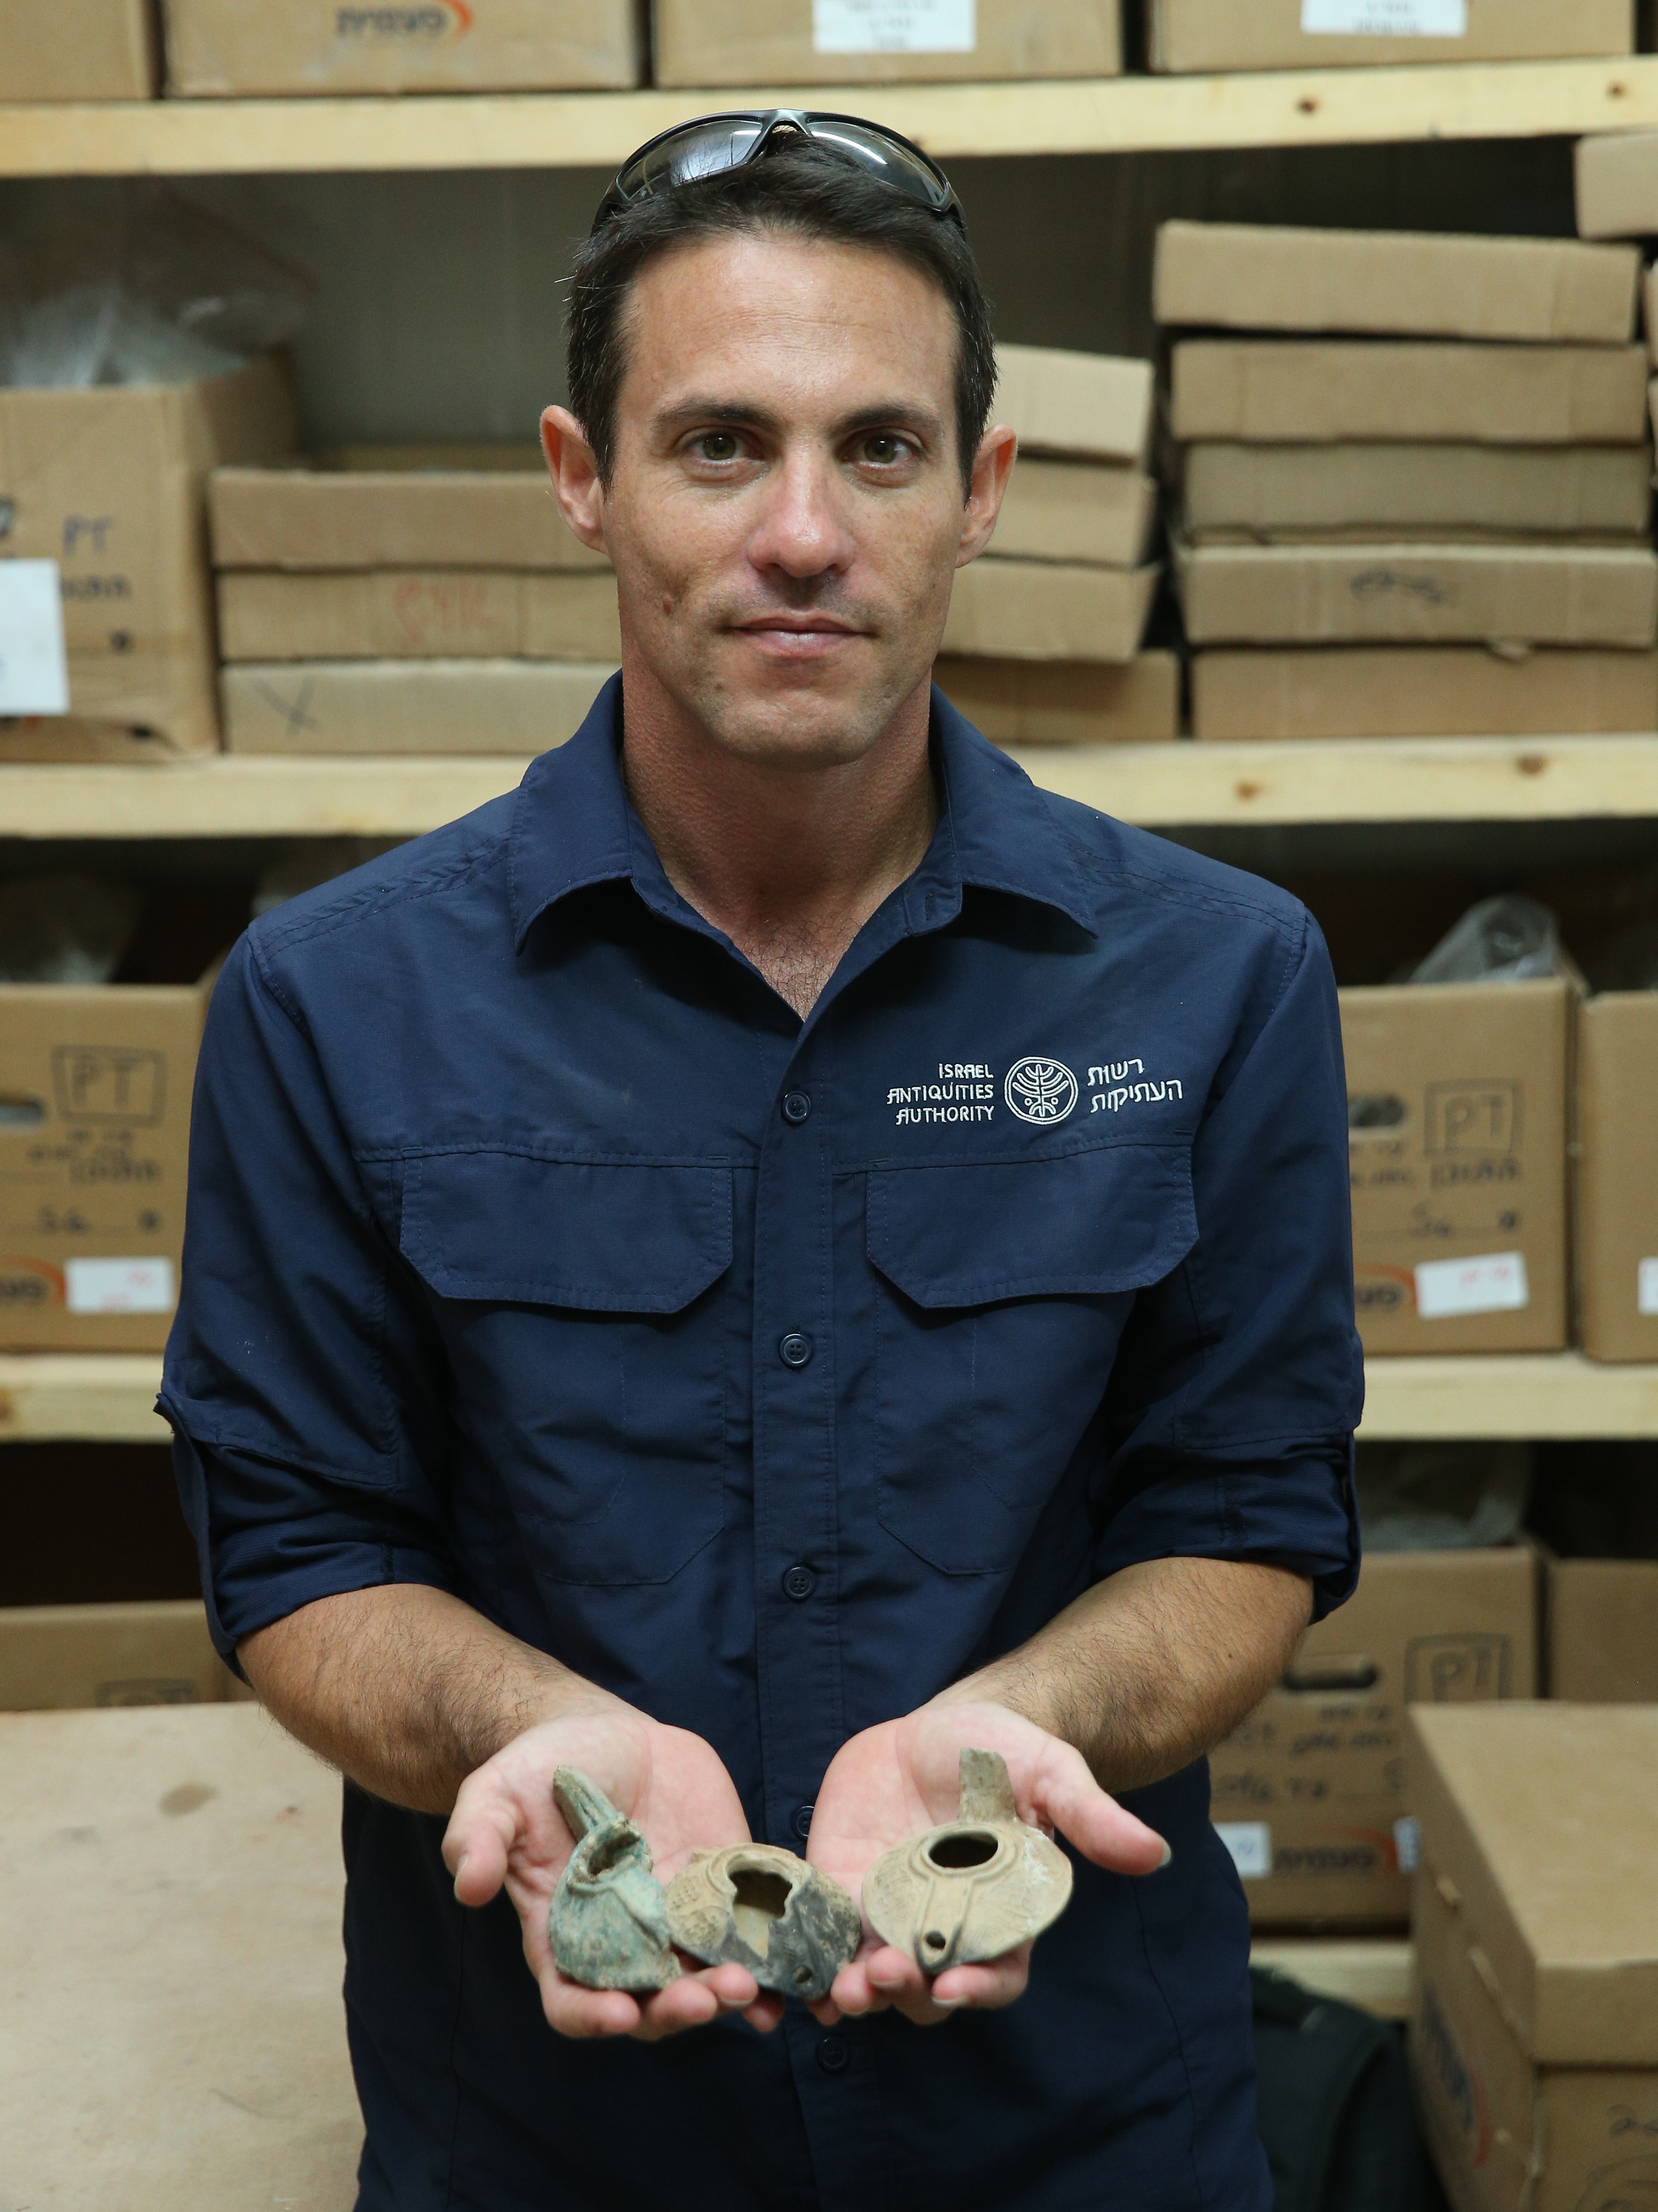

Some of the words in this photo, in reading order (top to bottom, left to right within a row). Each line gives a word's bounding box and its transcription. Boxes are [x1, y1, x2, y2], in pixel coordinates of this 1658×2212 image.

[939, 1063, 994, 1079] ISRAEL
[1087, 1058, 1145, 1086] רשות
[887, 1082, 994, 1104] ANTIQUITIES
[1090, 1080, 1183, 1113] העתיקות
[896, 1106, 995, 1125] AUTHORITY
